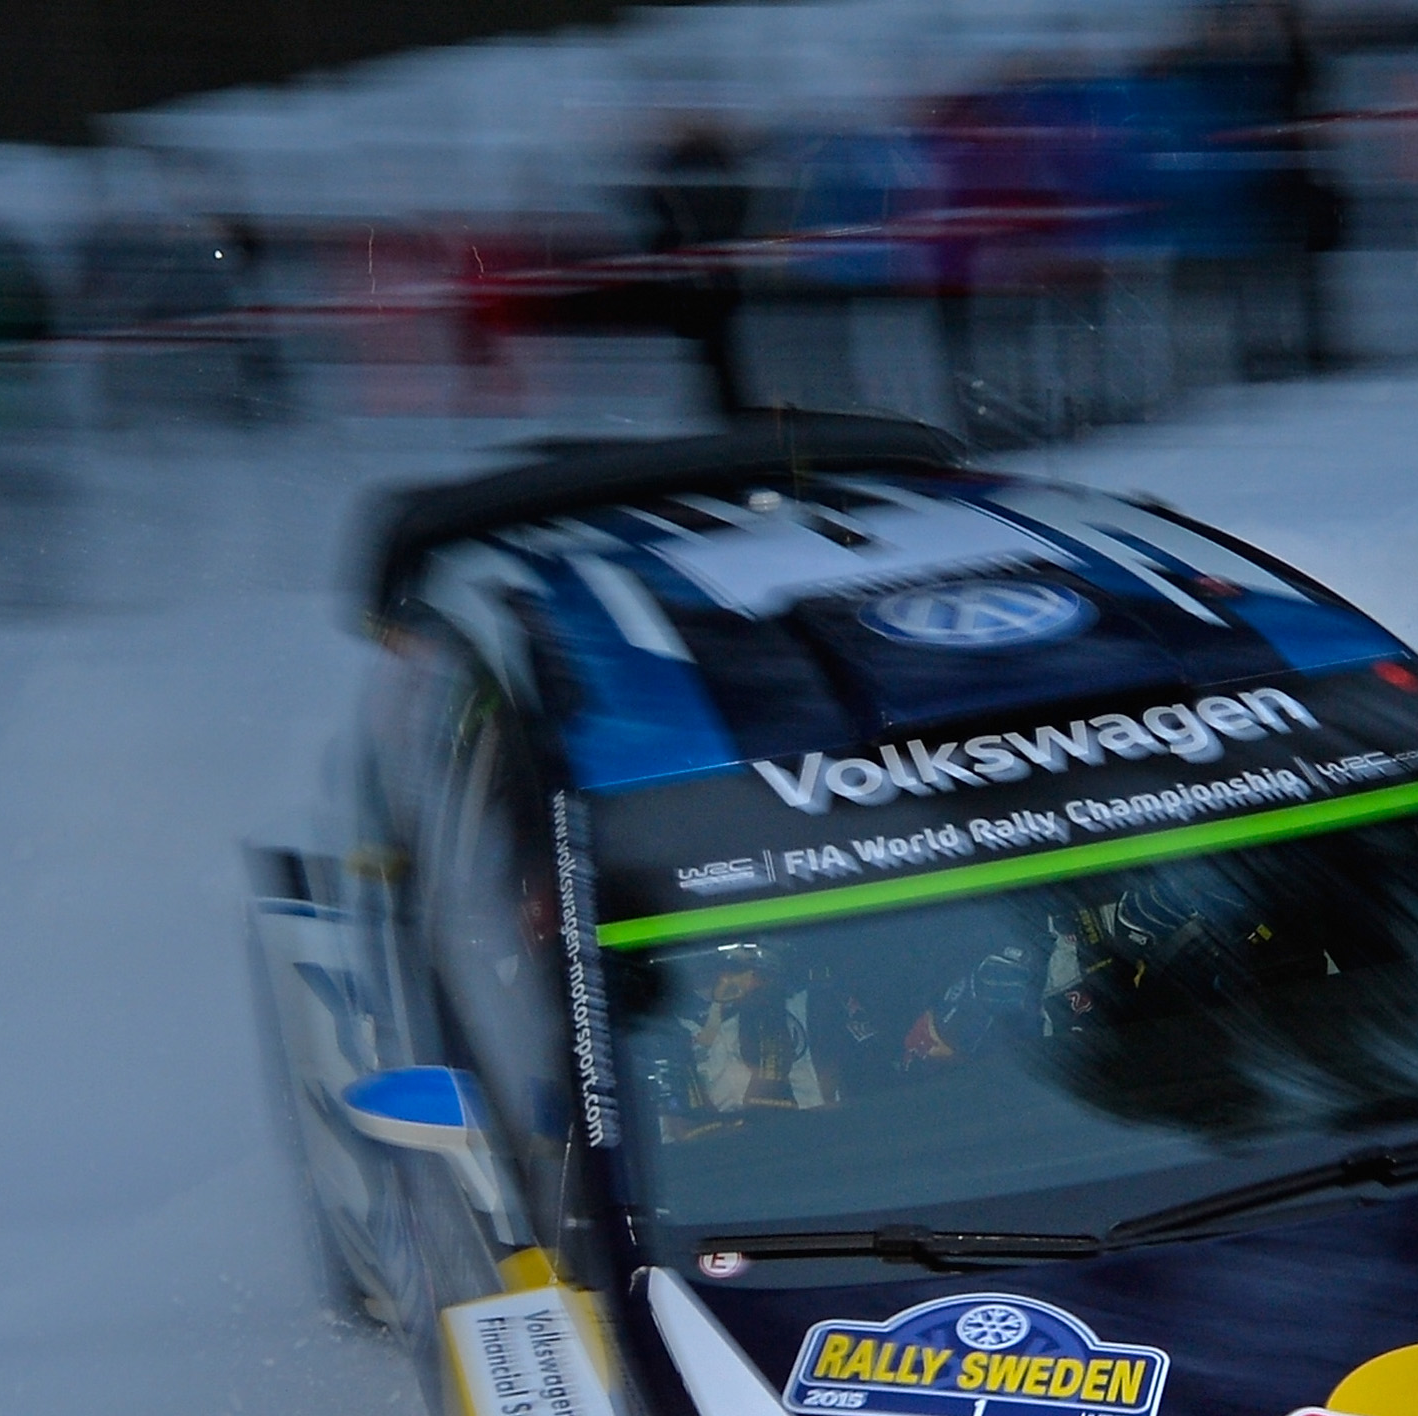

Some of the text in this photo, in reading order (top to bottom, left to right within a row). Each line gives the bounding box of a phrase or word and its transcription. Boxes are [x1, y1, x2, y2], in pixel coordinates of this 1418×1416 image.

[752, 686, 1320, 811] Volkswagen
[783, 845, 846, 876] FIA
[851, 824, 960, 864] World
[968, 809, 1056, 844] Rally
[1066, 765, 1298, 824] Championship
[552, 789, 606, 1148] www.volkswagen-motorsport.com
[476, 1317, 530, 1398] Financial
[806, 1389, 867, 1409] 2015
[813, 1333, 1147, 1405] RALLY SWEDEN
